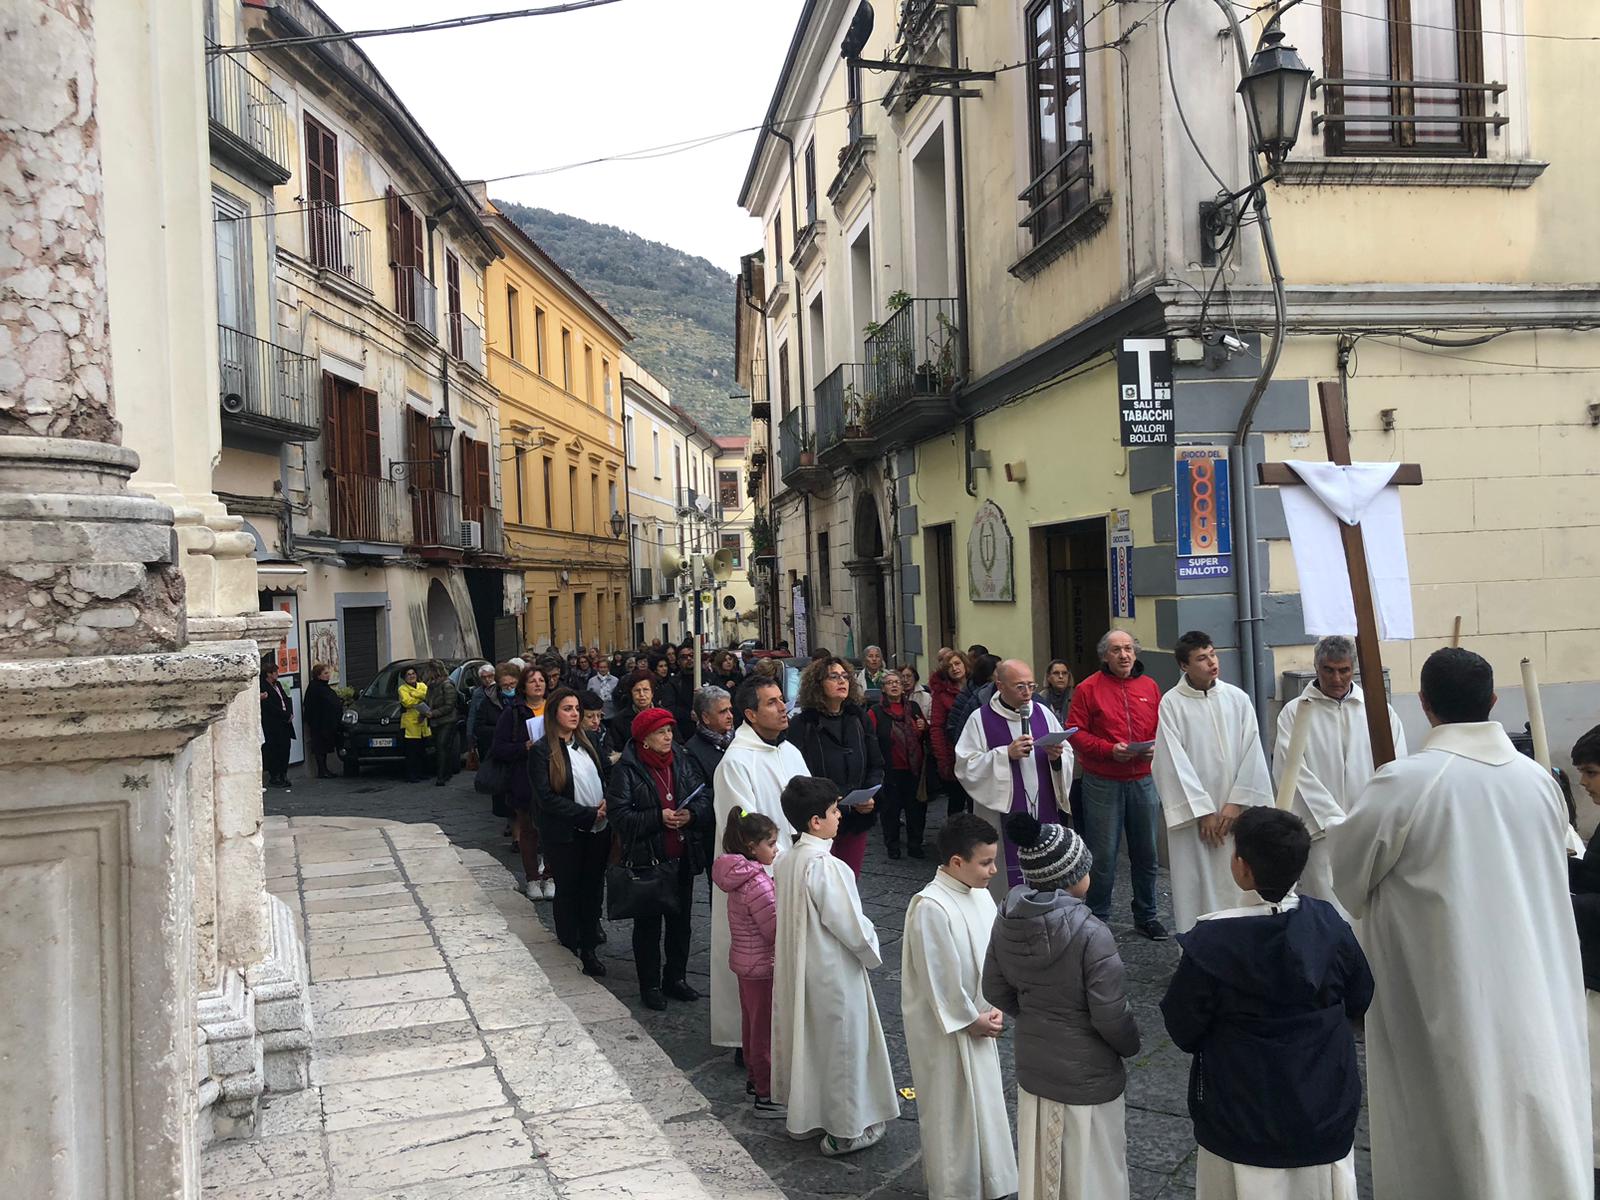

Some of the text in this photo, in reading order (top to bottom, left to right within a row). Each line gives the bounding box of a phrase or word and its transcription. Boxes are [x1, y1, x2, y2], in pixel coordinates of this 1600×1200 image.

[1123, 339, 1165, 400] T
[1133, 400, 1162, 409] SALI E
[1122, 409, 1173, 422] TABACCHI
[1131, 424, 1166, 433] VALORI
[1129, 433, 1168, 443] BOLLATI
[1181, 450, 1221, 459] GIOCO DEL
[1188, 557, 1219, 567] SUPER
[1179, 566, 1229, 576] ENALOTTO
